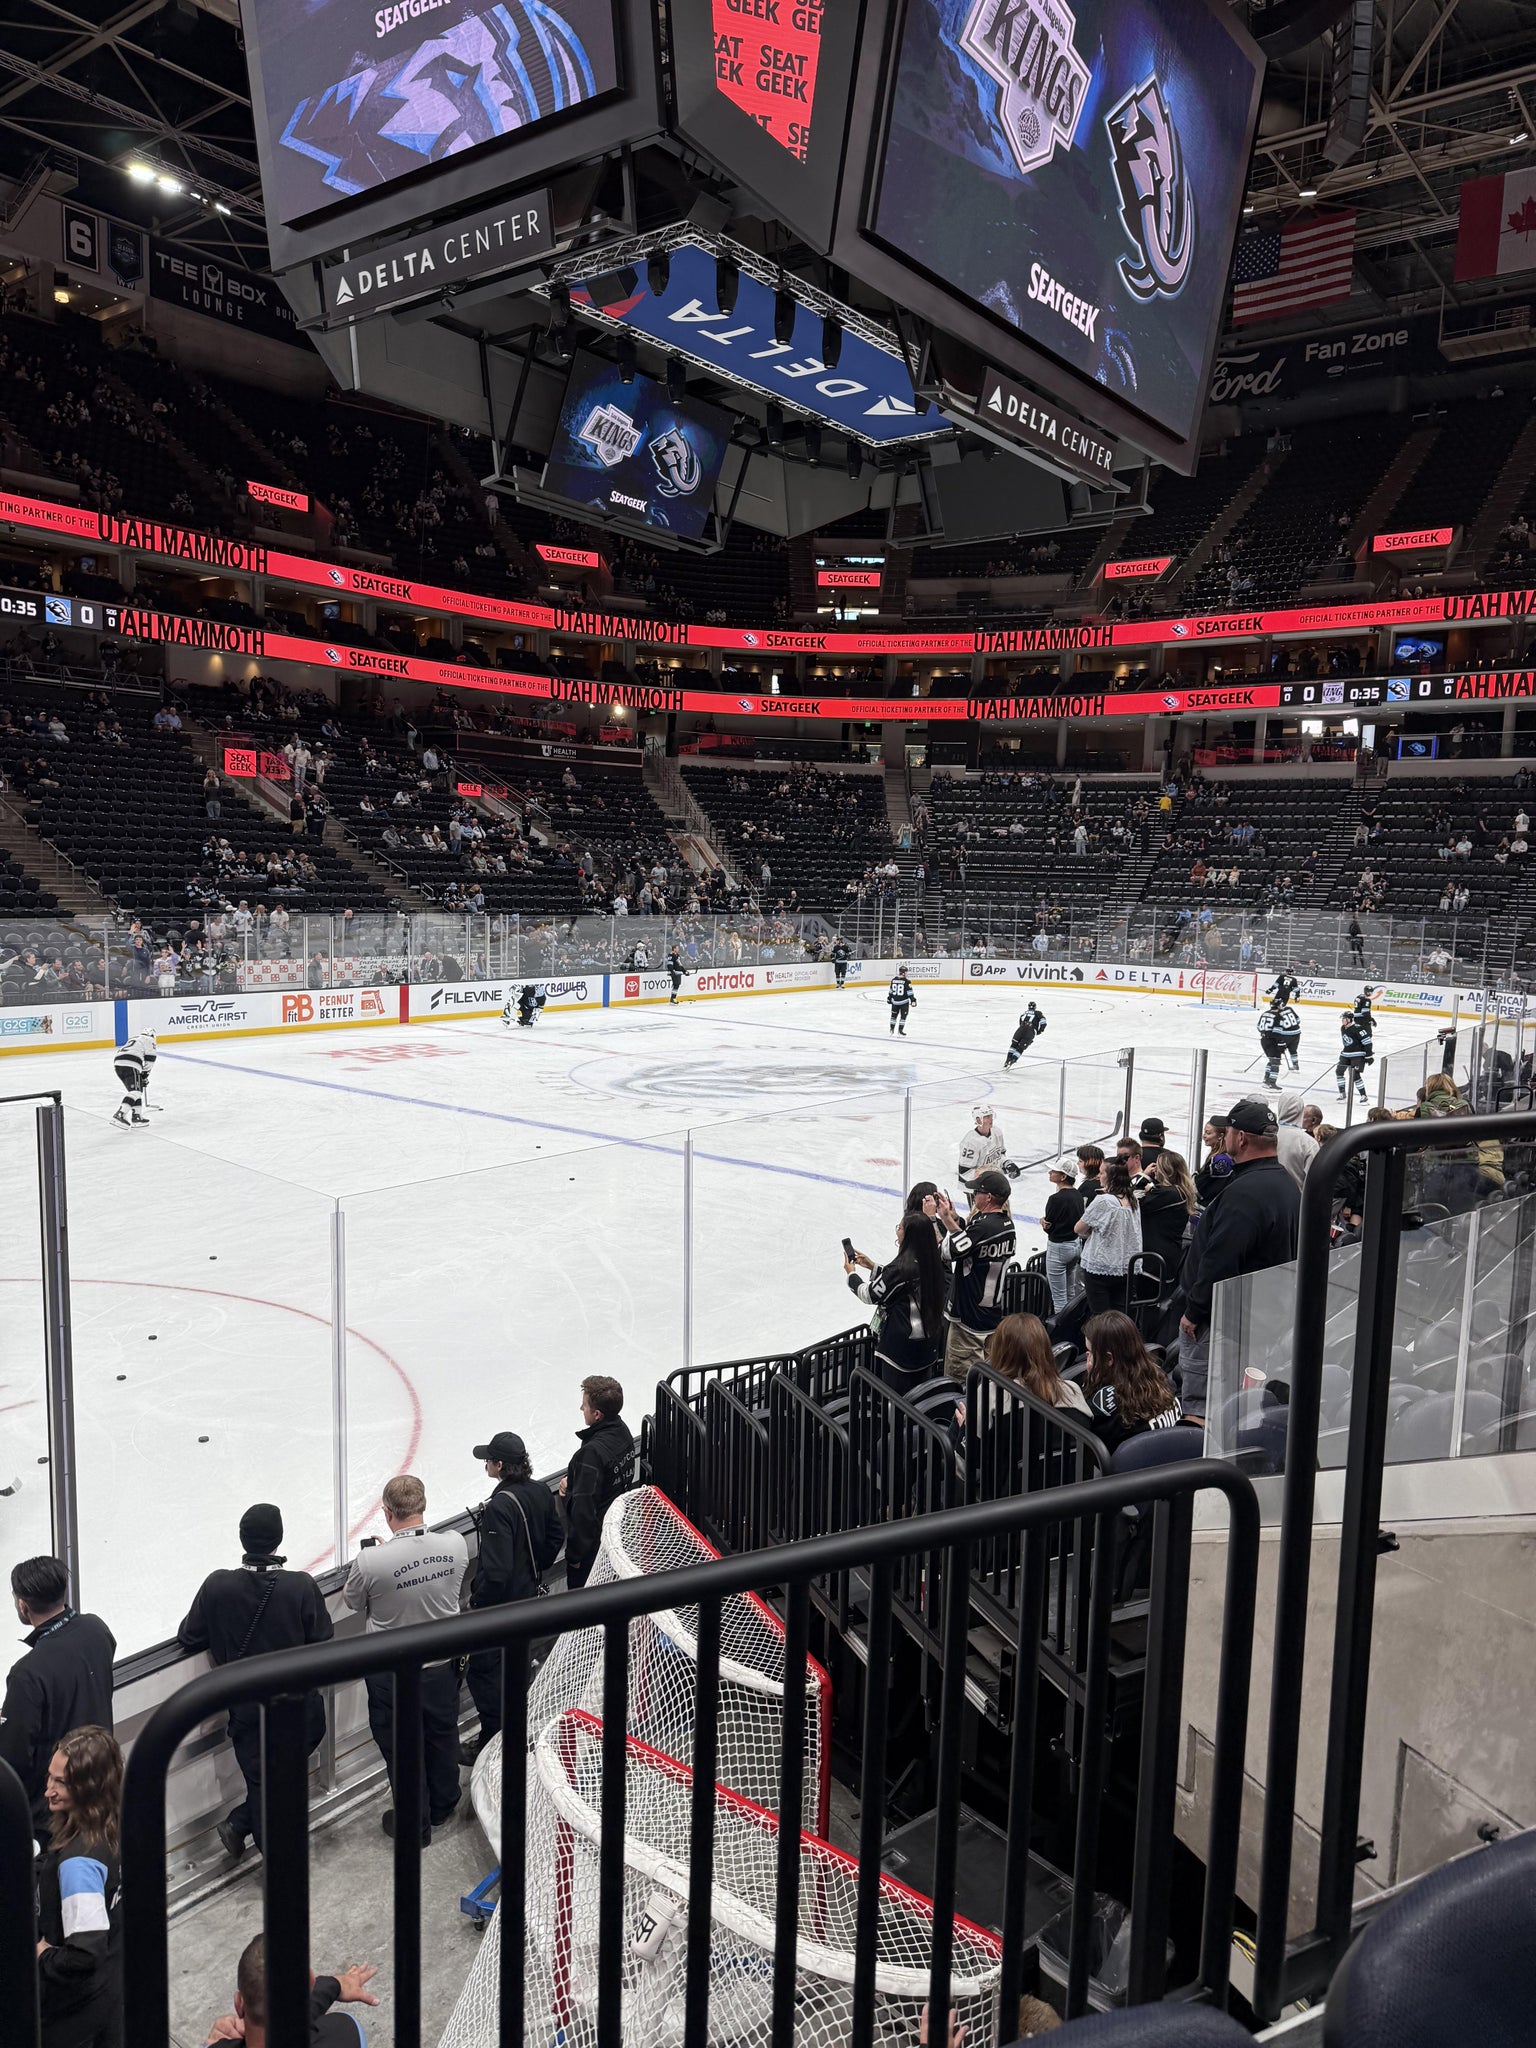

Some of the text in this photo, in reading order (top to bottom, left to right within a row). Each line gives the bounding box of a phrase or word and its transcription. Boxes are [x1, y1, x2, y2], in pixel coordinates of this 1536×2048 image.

[792, 9, 824, 34] GE
[713, 32, 744, 59] AT
[759, 45, 808, 76] SEAT
[983, 0, 1083, 129] KINGS
[755, 69, 808, 103] GEEK
[70, 219, 92, 258] 6
[358, 208, 542, 295] DELTA CENTER
[155, 251, 198, 281] TEE
[227, 278, 267, 307] BOX
[182, 285, 244, 321] LOUNGE
[1027, 262, 1101, 343] SEATGEEK
[667, 298, 870, 400] DELTA
[1304, 329, 1409, 363] Fan Zone
[589, 414, 638, 451] KINGS
[1005, 394, 1114, 472] DELTA CENTER
[252, 485, 299, 506] SEATGEEK
[609, 490, 648, 512] SEATGEEK
[22, 505, 63, 523] PARTNER
[65, 514, 77, 526] OF
[79, 517, 95, 530] THE
[97, 513, 155, 550] UTAH
[159, 525, 268, 574] MAMMOTH
[1385, 531, 1439, 548] SEATGEEK
[545, 547, 590, 564] SEATGEEK
[1115, 560, 1161, 575] SEATGEEK
[827, 573, 871, 585] SEATGEEK
[81, 606, 94, 625] 0
[106, 608, 117, 616] SOG
[352, 573, 412, 600] SEATGEEK
[442, 595, 469, 608] OFFICIAL
[469, 600, 502, 614] TICKETING
[502, 608, 530, 619] PARTNER
[531, 611, 540, 620] OF
[553, 608, 596, 635] UTAH
[600, 612, 689, 645] MAMMOTH
[1196, 616, 1263, 636] SEATGEEK
[1299, 612, 1334, 624] OFFICIAL
[1334, 609, 1375, 622] TICKETING
[1376, 606, 1411, 619] PARTNER
[1413, 606, 1424, 616] OF
[1425, 604, 1440, 615] THE
[1442, 594, 1501, 621] UTAH
[108, 616, 116, 628] 0
[157, 613, 265, 656] MAMMOTH
[766, 633, 827, 650] SEATGEEK
[857, 639, 886, 648] OFFICIAL
[888, 639, 920, 648] TICKETING
[921, 639, 949, 648] PARTNER
[950, 639, 960, 647] OF
[974, 631, 1017, 653] UTAH
[1021, 625, 1114, 651] MAMMOTH
[349, 651, 684, 711] SEATGEEK OFFICIAL TICKETING PARTNER OF THE UTAH MAMMOTH
[1419, 680, 1431, 697] 0
[1444, 684, 1452, 695] 0
[1187, 690, 1255, 708] SEATGEEK
[1303, 686, 1315, 702] 0
[1350, 687, 1380, 700] 0:35
[761, 699, 821, 714] SEATGEEK
[851, 705, 879, 713] OFFICIAL
[881, 705, 913, 713] TICKETING
[914, 705, 942, 713] PARTNER
[944, 705, 951, 713] OF
[967, 699, 1010, 719] UTAH
[1014, 696, 1105, 719] MAMMOTH
[230, 752, 251, 763] SEAT
[553, 747, 577, 756] HEALTH
[229, 762, 252, 772] GEEK
[697, 970, 755, 991] entrata
[1017, 963, 1069, 981] vivint
[1115, 969, 1172, 984] DELTA
[1189, 971, 1243, 993] Coca-Cola
[643, 979, 672, 991] TOYOT
[892, 984, 905, 996] 98
[1314, 988, 1336, 997] FIRST
[319, 994, 354, 1007] PEANUT
[444, 989, 502, 1005] FILEVINE
[1385, 990, 1443, 1003] SameDay
[168, 1011, 248, 1025] AMERICA FIRST
[281, 994, 314, 1023] PB
[288, 1010, 298, 1023] fit
[319, 1006, 354, 1019] BETTER
[1474, 1004, 1525, 1016] EXPRES
[3, 1020, 27, 1030] G2G
[66, 1015, 89, 1026] G2G
[951, 1230, 973, 1252] 10
[1105, 1385, 1118, 1410] UTAH
[393, 1555, 454, 1579] GOLD CROSS
[396, 1567, 455, 1590] AMBULANCE
